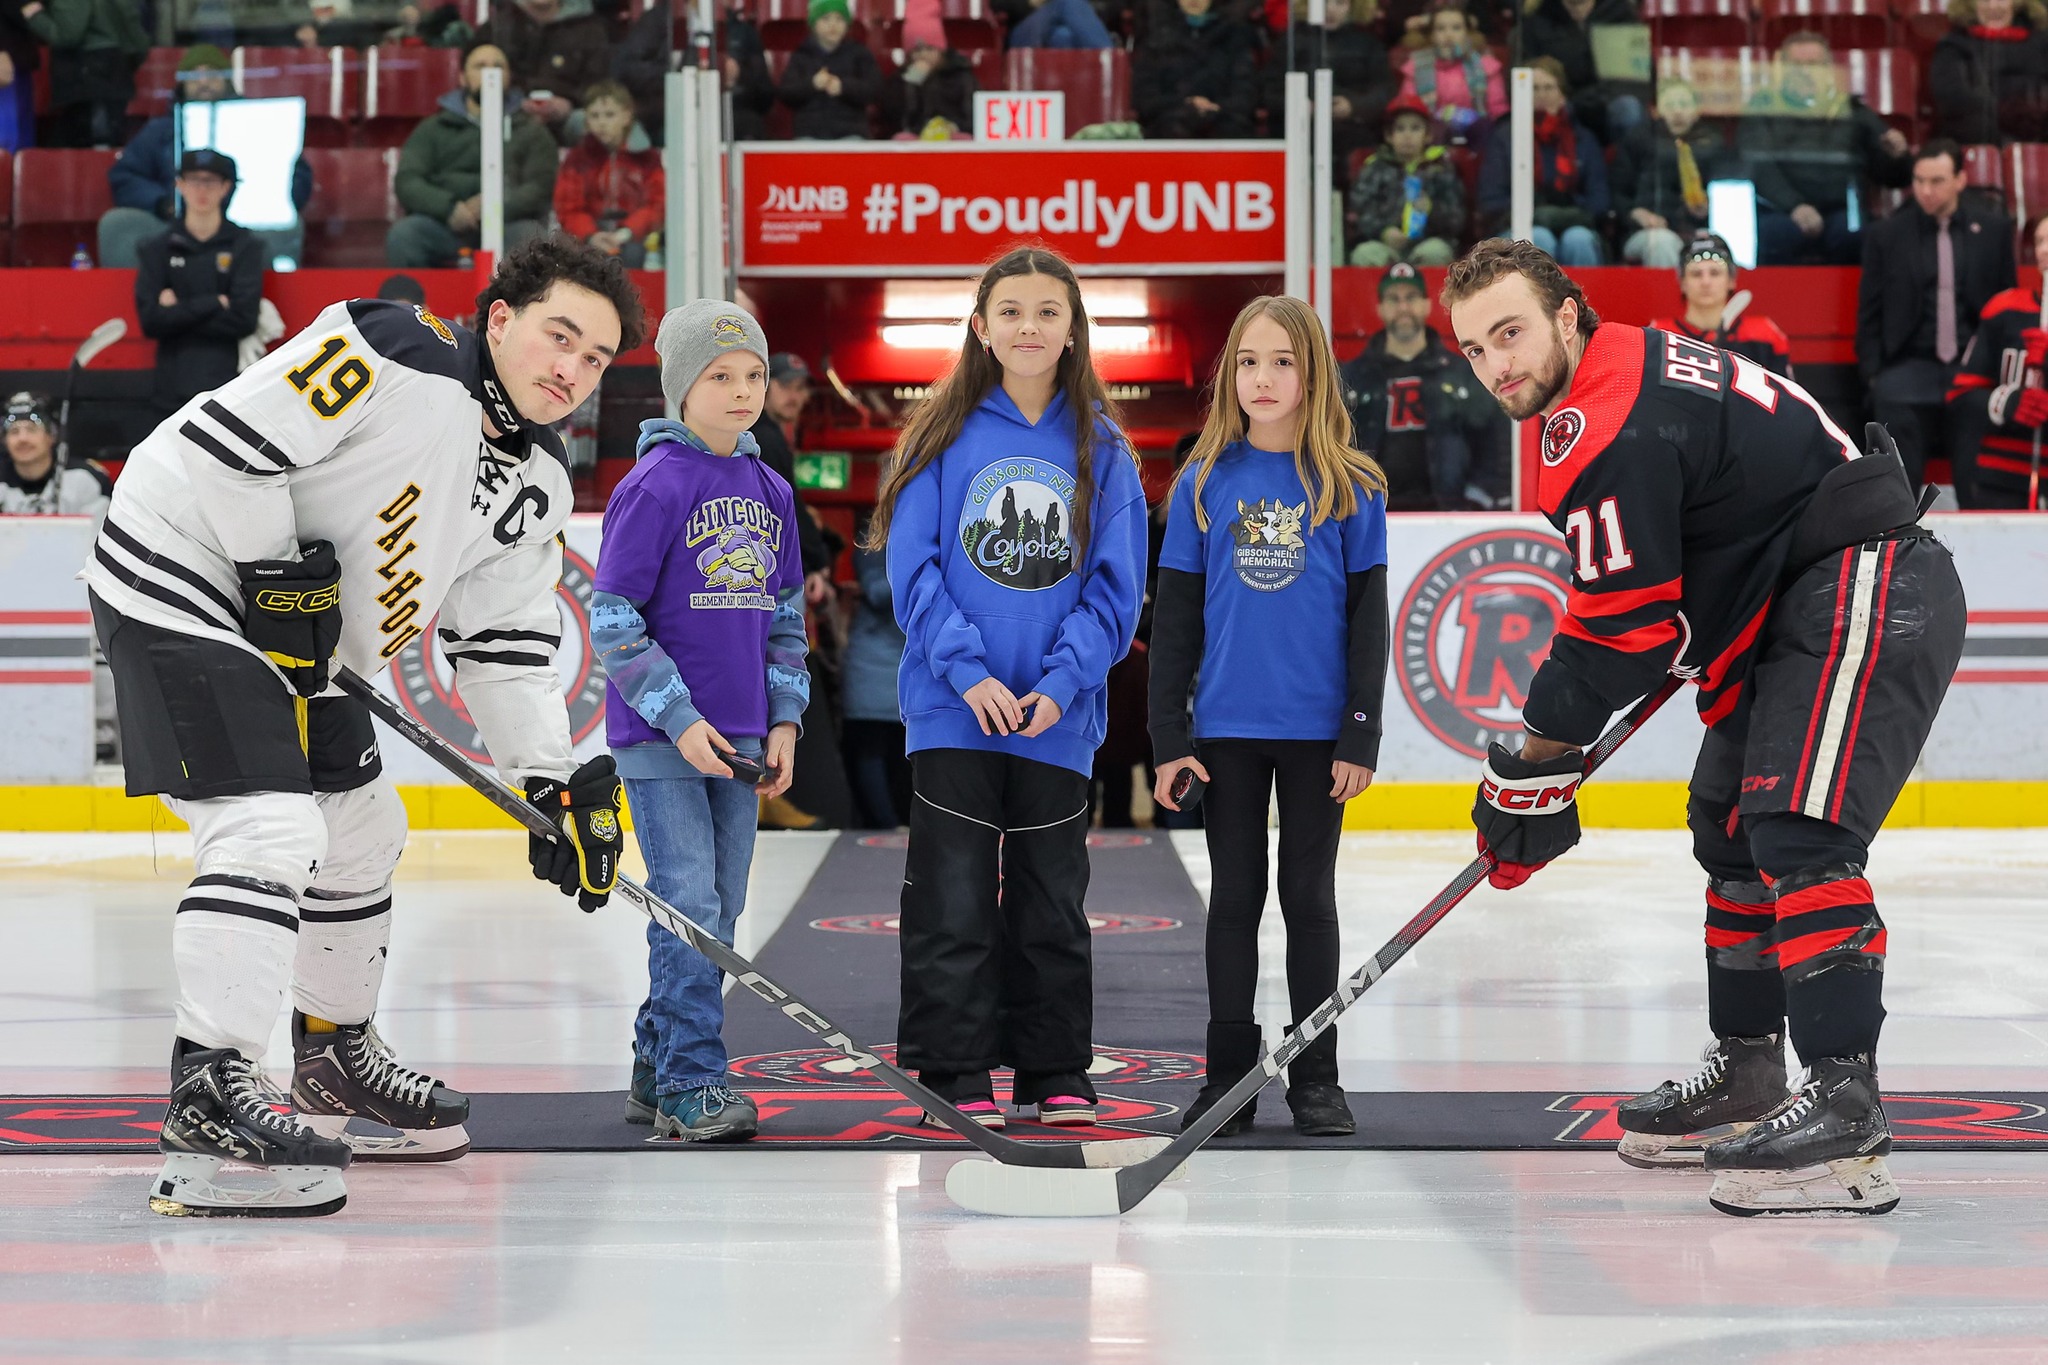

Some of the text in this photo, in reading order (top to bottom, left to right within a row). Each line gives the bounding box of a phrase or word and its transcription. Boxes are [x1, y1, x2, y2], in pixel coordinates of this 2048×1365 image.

[986, 100, 1051, 140] EXIT
[786, 185, 849, 212] UNB
[862, 178, 1276, 248] #ProudlyUNB
[284, 335, 374, 420] 19
[972, 464, 1035, 506] GIBSON
[493, 484, 549, 546] C
[685, 497, 782, 552] LINCOLN
[977, 529, 1070, 576] Coyotes
[1237, 548, 1299, 559] GIBSON-NEILL
[1565, 496, 1634, 582] 71
[1239, 571, 1296, 590] ELEMENTARY SCHOOL
[1240, 558, 1294, 568] MEMORIAL
[256, 579, 341, 613] CC
[1404, 541, 1562, 703] UNIVERSITY OF NEW
[532, 784, 555, 802] CCM
[1482, 778, 1581, 810] CCM
[601, 854, 609, 884] CCM
[622, 886, 644, 904] PRO
[738, 971, 882, 1070] CCM
[1261, 955, 1383, 1078] CCM
[306, 1076, 357, 1116] CCM
[182, 1104, 249, 1160] CCM
